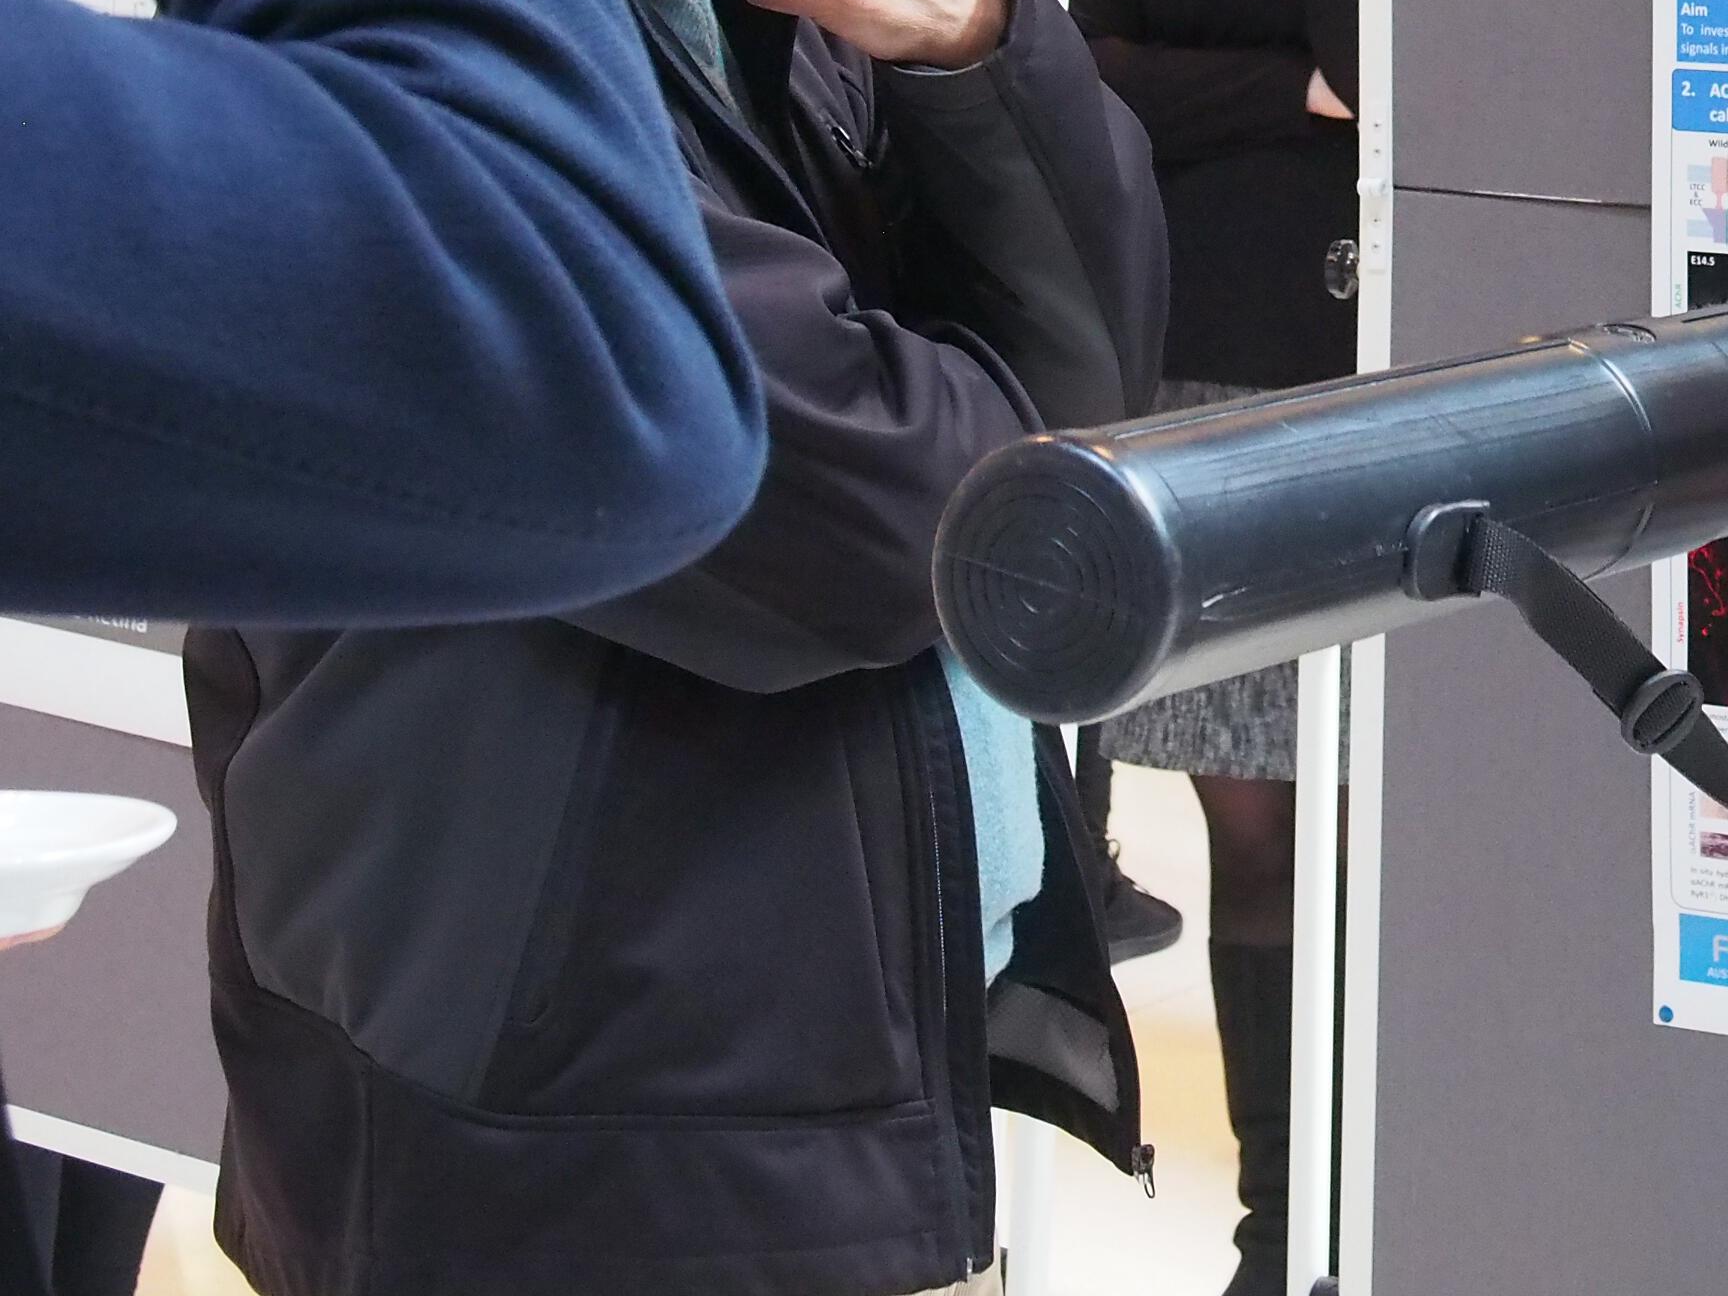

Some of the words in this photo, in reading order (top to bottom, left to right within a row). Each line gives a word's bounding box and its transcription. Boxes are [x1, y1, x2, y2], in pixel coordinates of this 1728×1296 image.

[1681, 3, 1707, 16] Aim
[1681, 23, 1693, 35] To
[1682, 81, 1695, 96] 2.
[1691, 256, 1715, 266] E14.5
